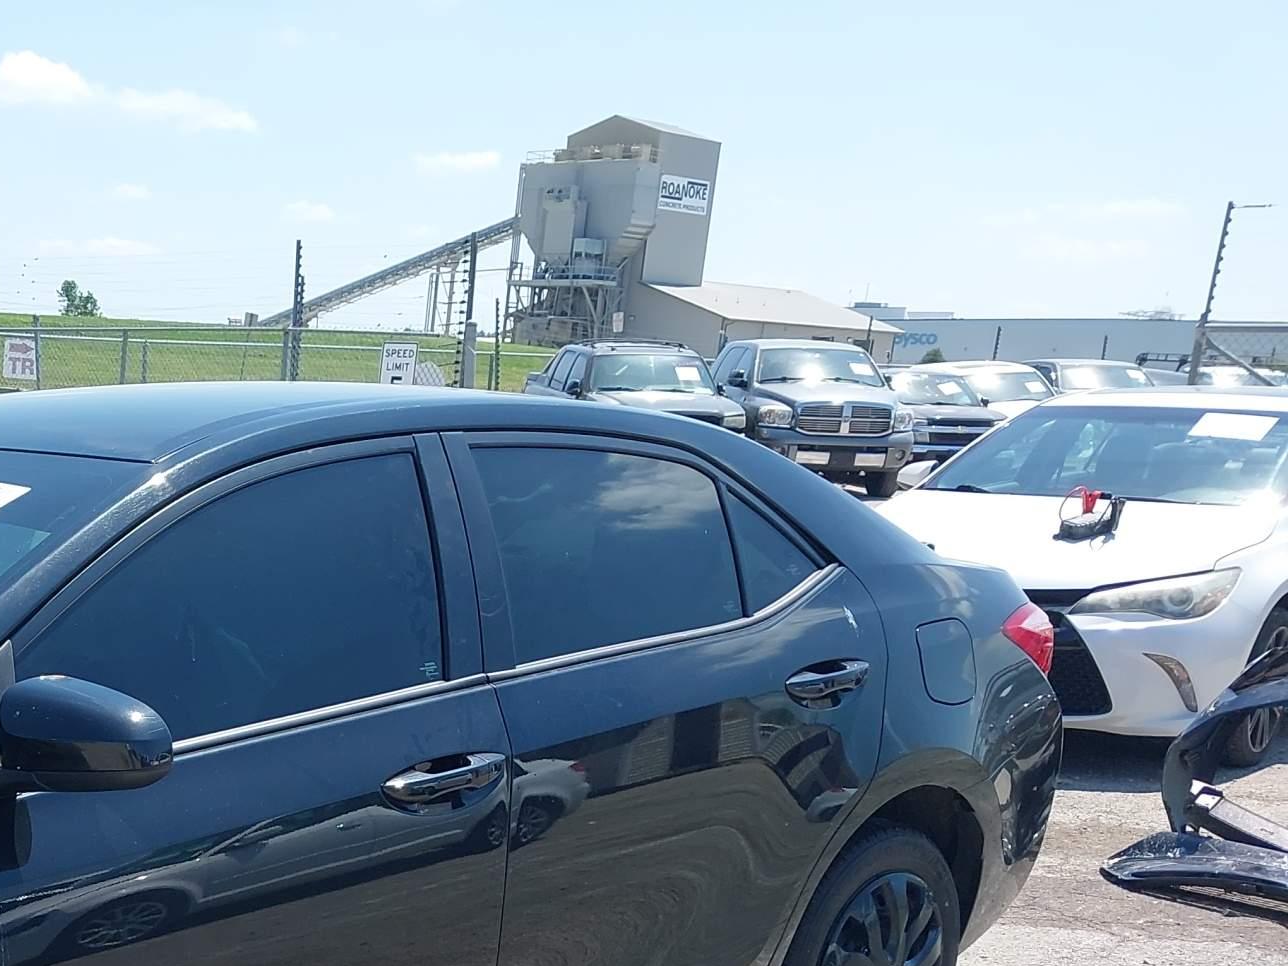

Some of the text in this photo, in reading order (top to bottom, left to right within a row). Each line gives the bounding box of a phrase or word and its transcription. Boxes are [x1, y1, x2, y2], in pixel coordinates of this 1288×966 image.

[661, 181, 708, 200] ROANOKE
[384, 348, 415, 359] SPEED
[8, 356, 35, 375] TR
[385, 362, 410, 372] LIMIT
